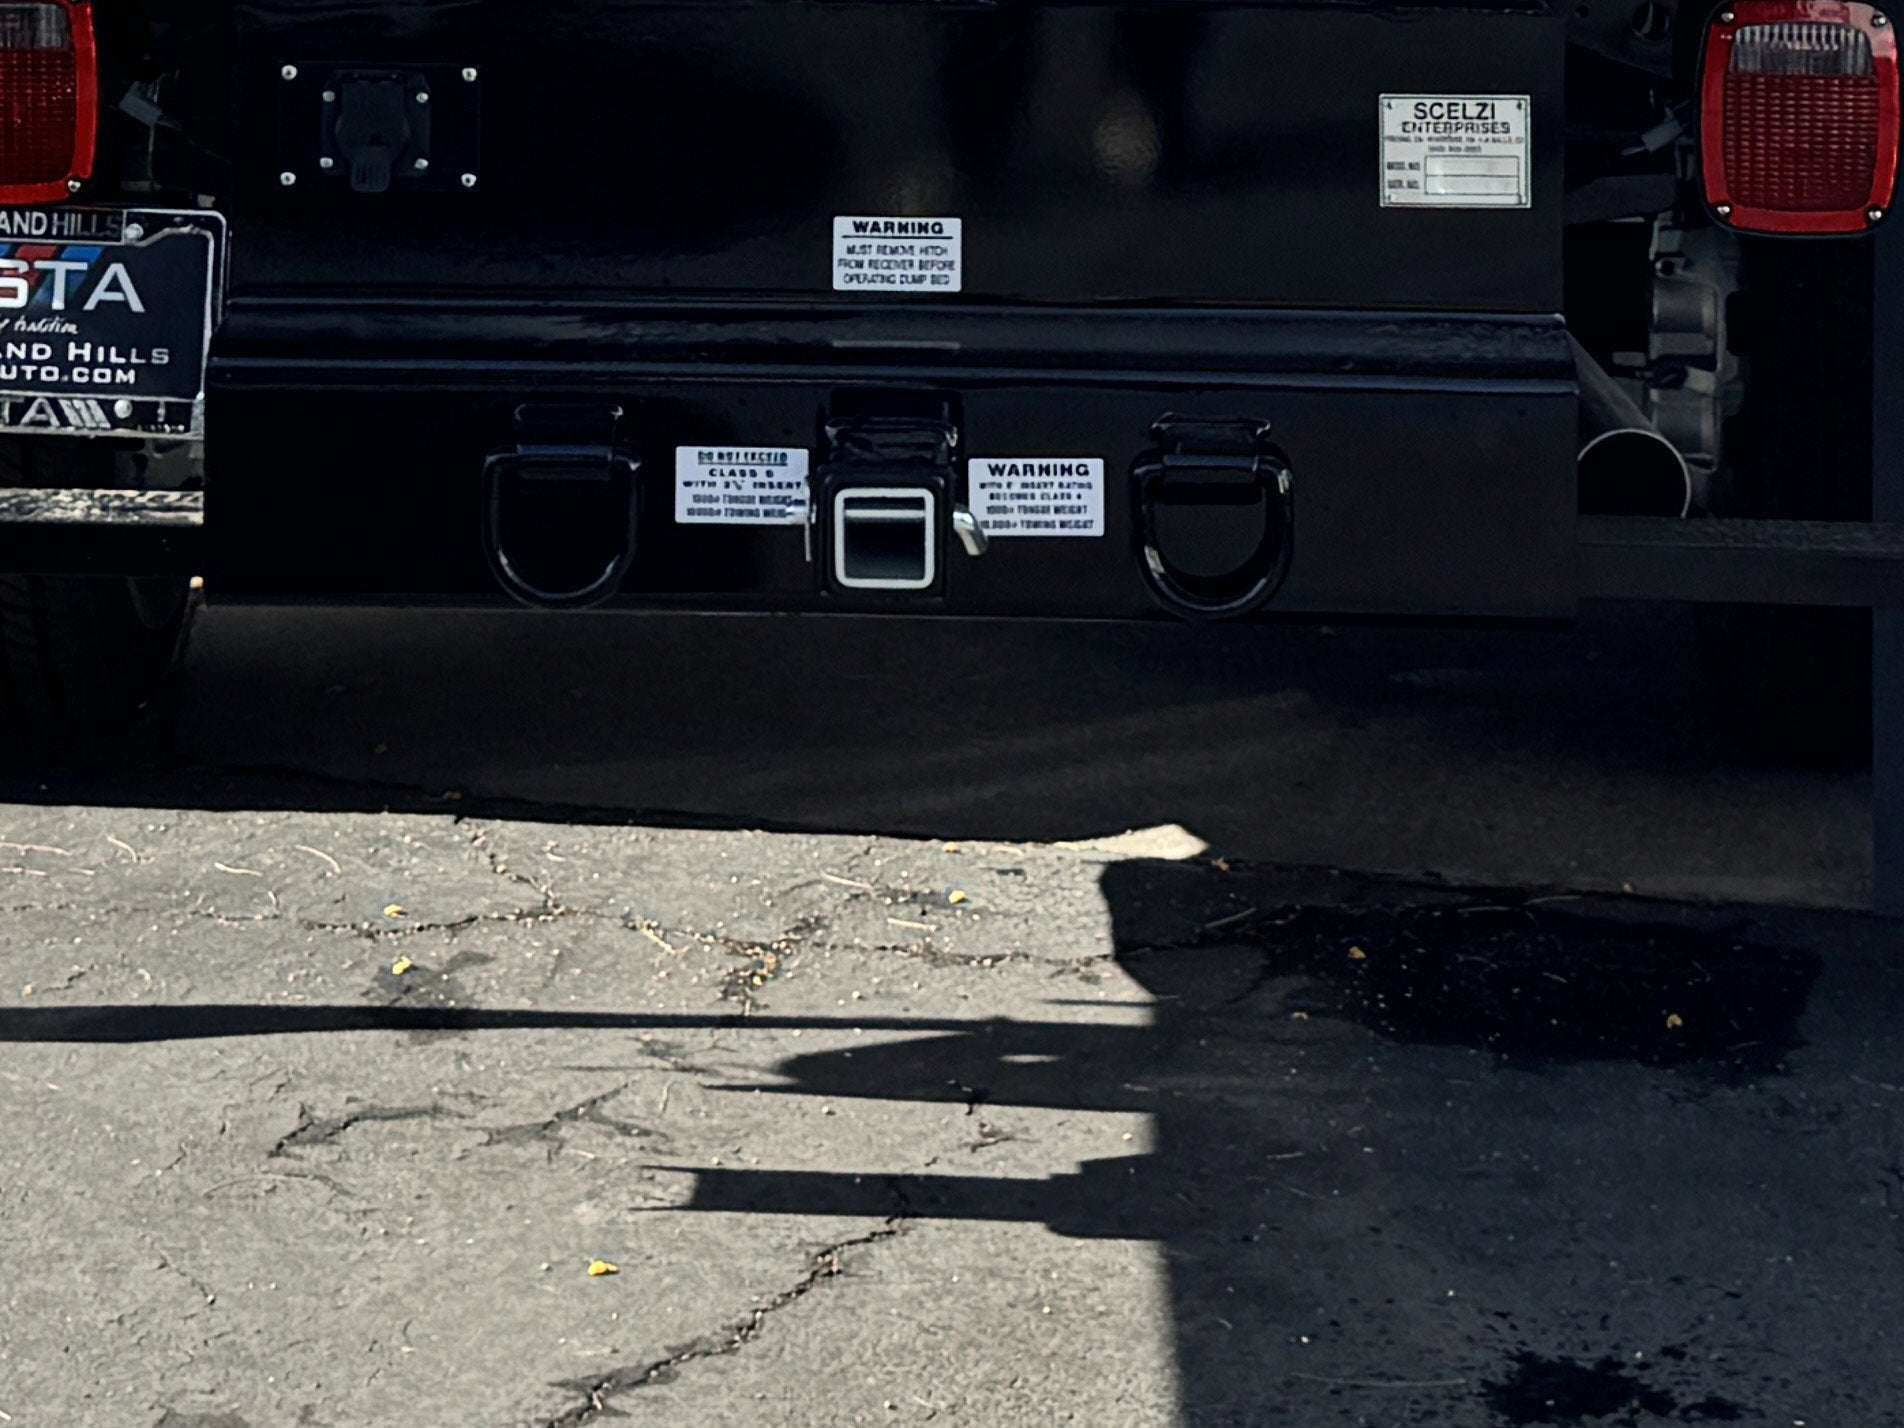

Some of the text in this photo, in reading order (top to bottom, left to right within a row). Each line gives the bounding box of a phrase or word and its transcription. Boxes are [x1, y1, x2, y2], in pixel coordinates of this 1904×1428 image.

[1413, 101, 1496, 120] SCELZI
[1401, 120, 1511, 134] ENTERPRISES
[51, 211, 120, 237] HILLS
[852, 220, 944, 235] WARNING
[67, 341, 170, 365] HILLS
[987, 463, 1090, 477] WARNING
